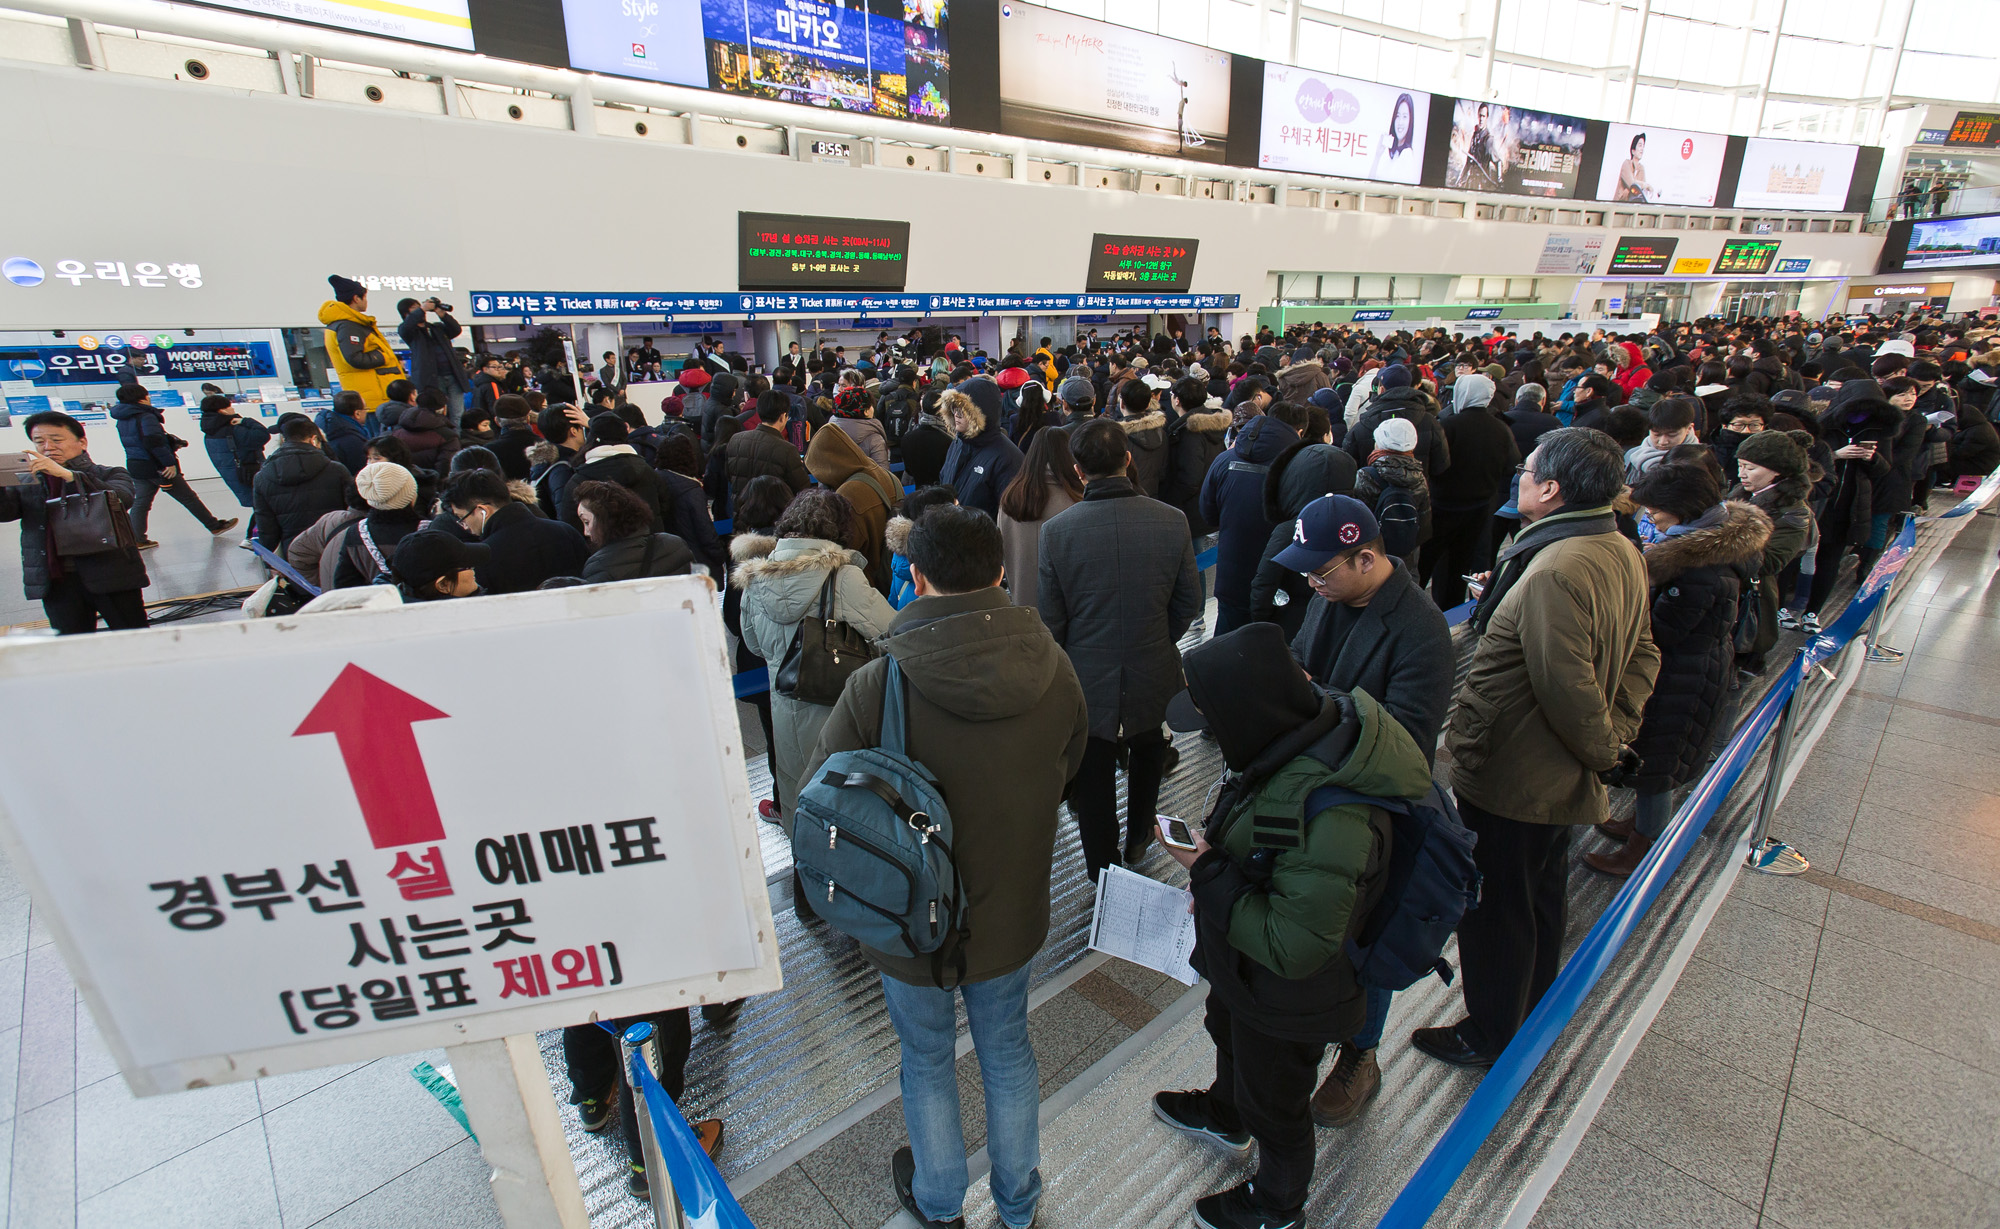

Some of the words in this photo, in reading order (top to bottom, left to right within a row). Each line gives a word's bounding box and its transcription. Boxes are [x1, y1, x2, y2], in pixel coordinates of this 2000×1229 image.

[622, 0, 659, 22] Style
[776, 9, 842, 50] 마카오
[1123, 101, 1149, 114] 대한민국의
[1280, 125, 1312, 147] 우체국
[1316, 127, 1368, 158] 체크카드
[757, 232, 778, 243] '17년
[782, 233, 790, 244] 설
[794, 234, 819, 245] 승차권
[822, 235, 839, 246] 사는
[1104, 243, 1121, 256] 오늘
[1122, 244, 1145, 257] 승차권
[1146, 245, 1162, 257] 사는
[1163, 246, 1172, 258] 곳
[829, 263, 850, 273] 표사는
[852, 264, 860, 273] 곳
[1119, 260, 1132, 270] 서부
[1134, 260, 1159, 270] 10~12번
[55, 260, 203, 289] 우리은행
[1103, 270, 1137, 282] 자동발매기,
[1151, 272, 1169, 282] 표사는
[1170, 272, 1177, 282] 곳
[496, 296, 540, 312] 표사는
[543, 296, 557, 312] 곳
[560, 298, 592, 310] Ticket
[755, 296, 786, 309] 표사는
[788, 296, 798, 309] 곳
[800, 298, 823, 308] Ticket
[942, 296, 966, 308] 표사는
[967, 296, 975, 308] 곳
[977, 297, 995, 307] Ticket
[1087, 296, 1106, 306] 표사는
[1107, 296, 1114, 307] 곳
[1115, 297, 1130, 306] Ticket
[167, 350, 213, 362] WOORI
[48, 353, 160, 376] 우리은
[170, 360, 250, 373] 서울역환전센터
[1293, 518, 1308, 544] A
[150, 859, 365, 932] 경부선
[387, 846, 455, 901] 설
[474, 816, 667, 886] 예매표
[347, 898, 537, 969] 사는곳
